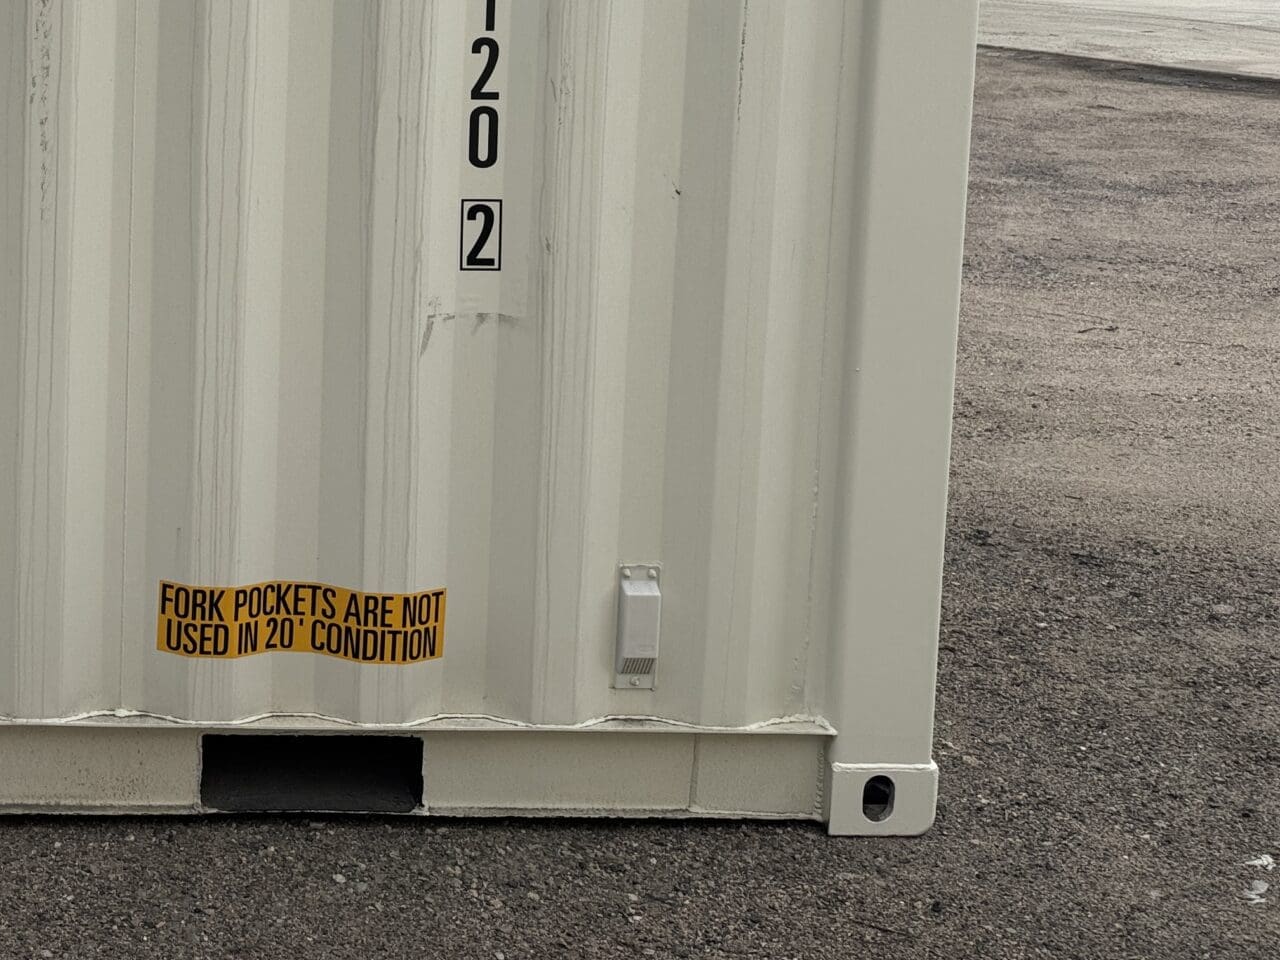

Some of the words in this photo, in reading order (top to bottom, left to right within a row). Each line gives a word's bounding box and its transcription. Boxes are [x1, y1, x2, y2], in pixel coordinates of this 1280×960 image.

[466, 203, 495, 267] 2
[161, 583, 224, 622] FORK
[234, 583, 336, 622] POCKETS
[343, 593, 394, 628] ARE
[401, 590, 444, 628] NOT
[166, 618, 229, 656] USED
[238, 620, 258, 655] IN
[265, 617, 304, 650] 20'
[310, 619, 437, 662] CONDITION
